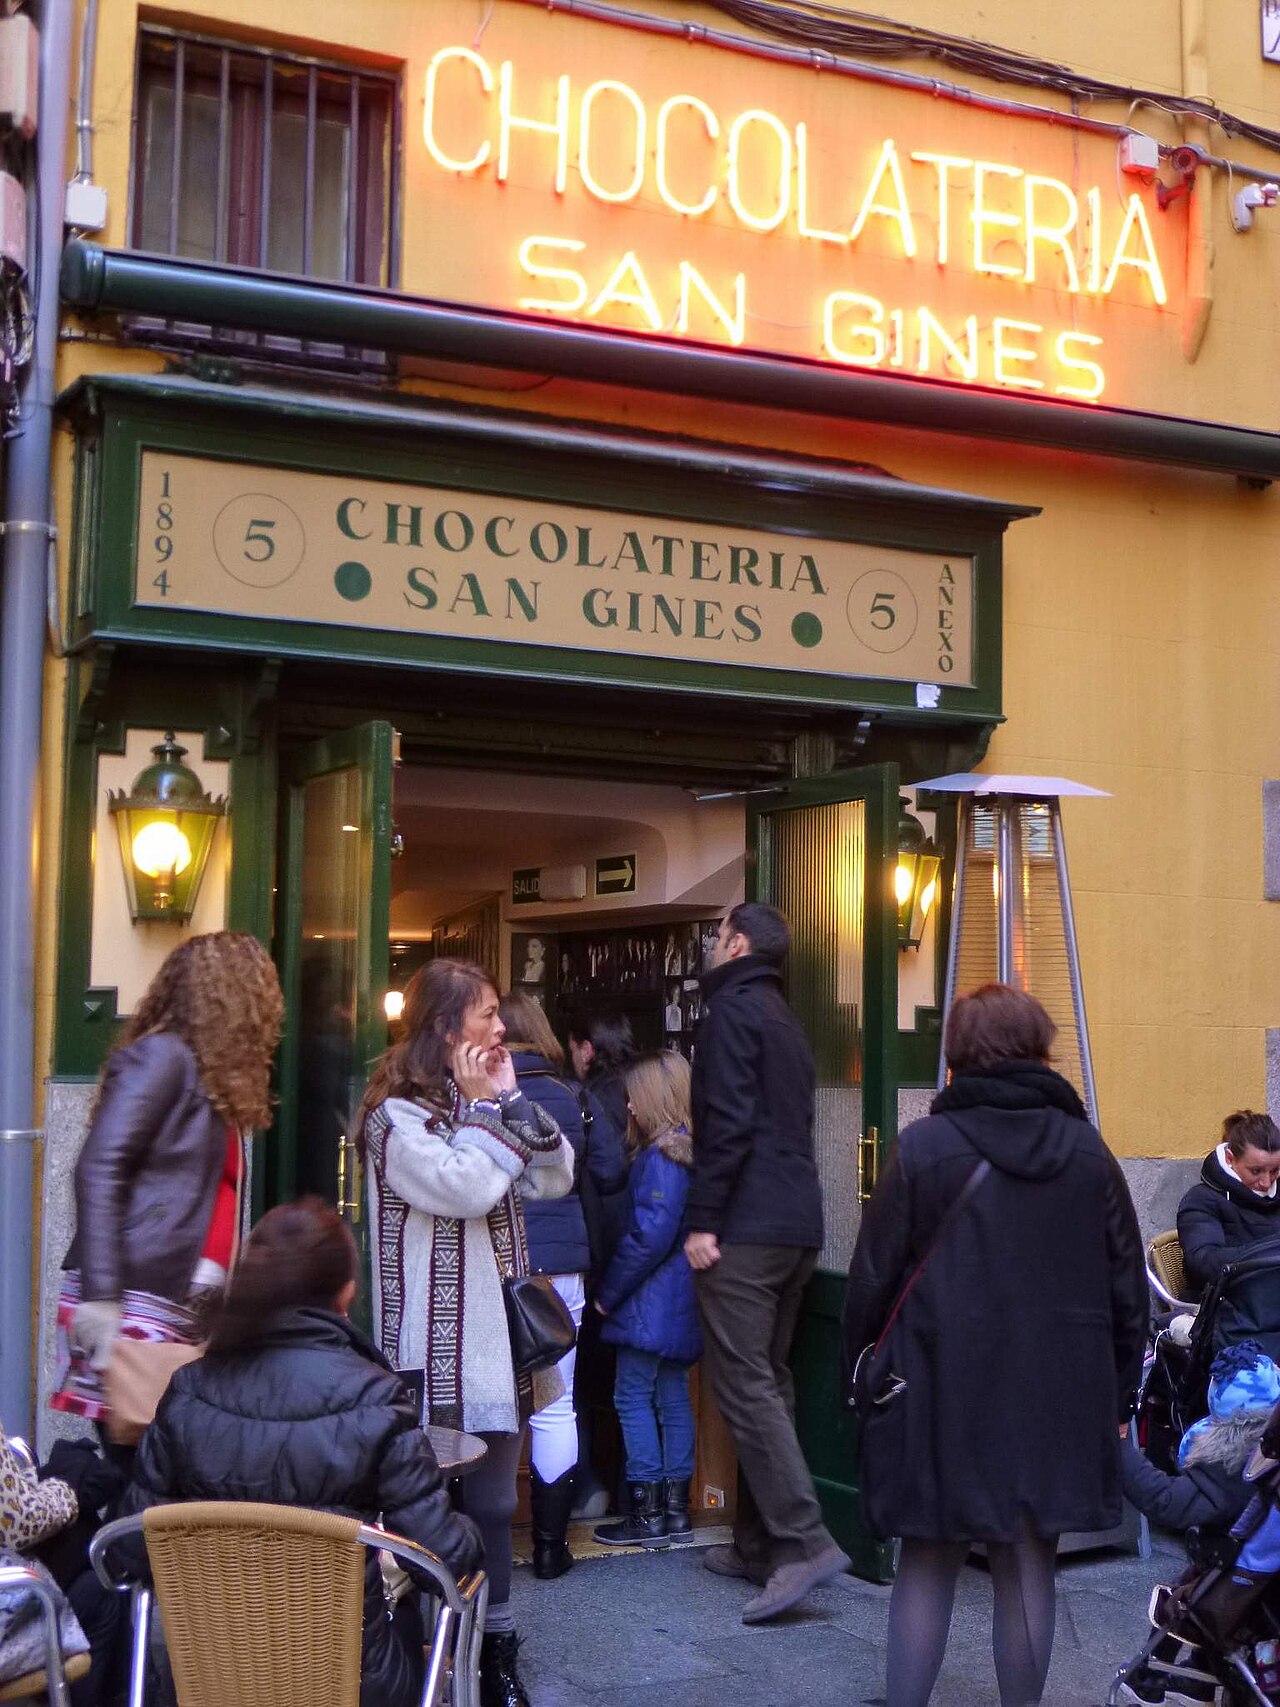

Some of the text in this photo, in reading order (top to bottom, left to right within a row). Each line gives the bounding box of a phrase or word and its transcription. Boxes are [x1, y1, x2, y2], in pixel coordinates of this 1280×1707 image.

[423, 46, 1167, 305] CHOCOLATERIA
[518, 235, 1105, 403] SAN GINES
[151, 470, 174, 597] 1894
[243, 518, 276, 563] 5
[335, 497, 829, 596] CHOCOLATERIA
[402, 566, 763, 644] SAN GINES
[869, 592, 896, 631] 5
[936, 562, 957, 674] ANEXO
[513, 877, 541, 896] SALID
